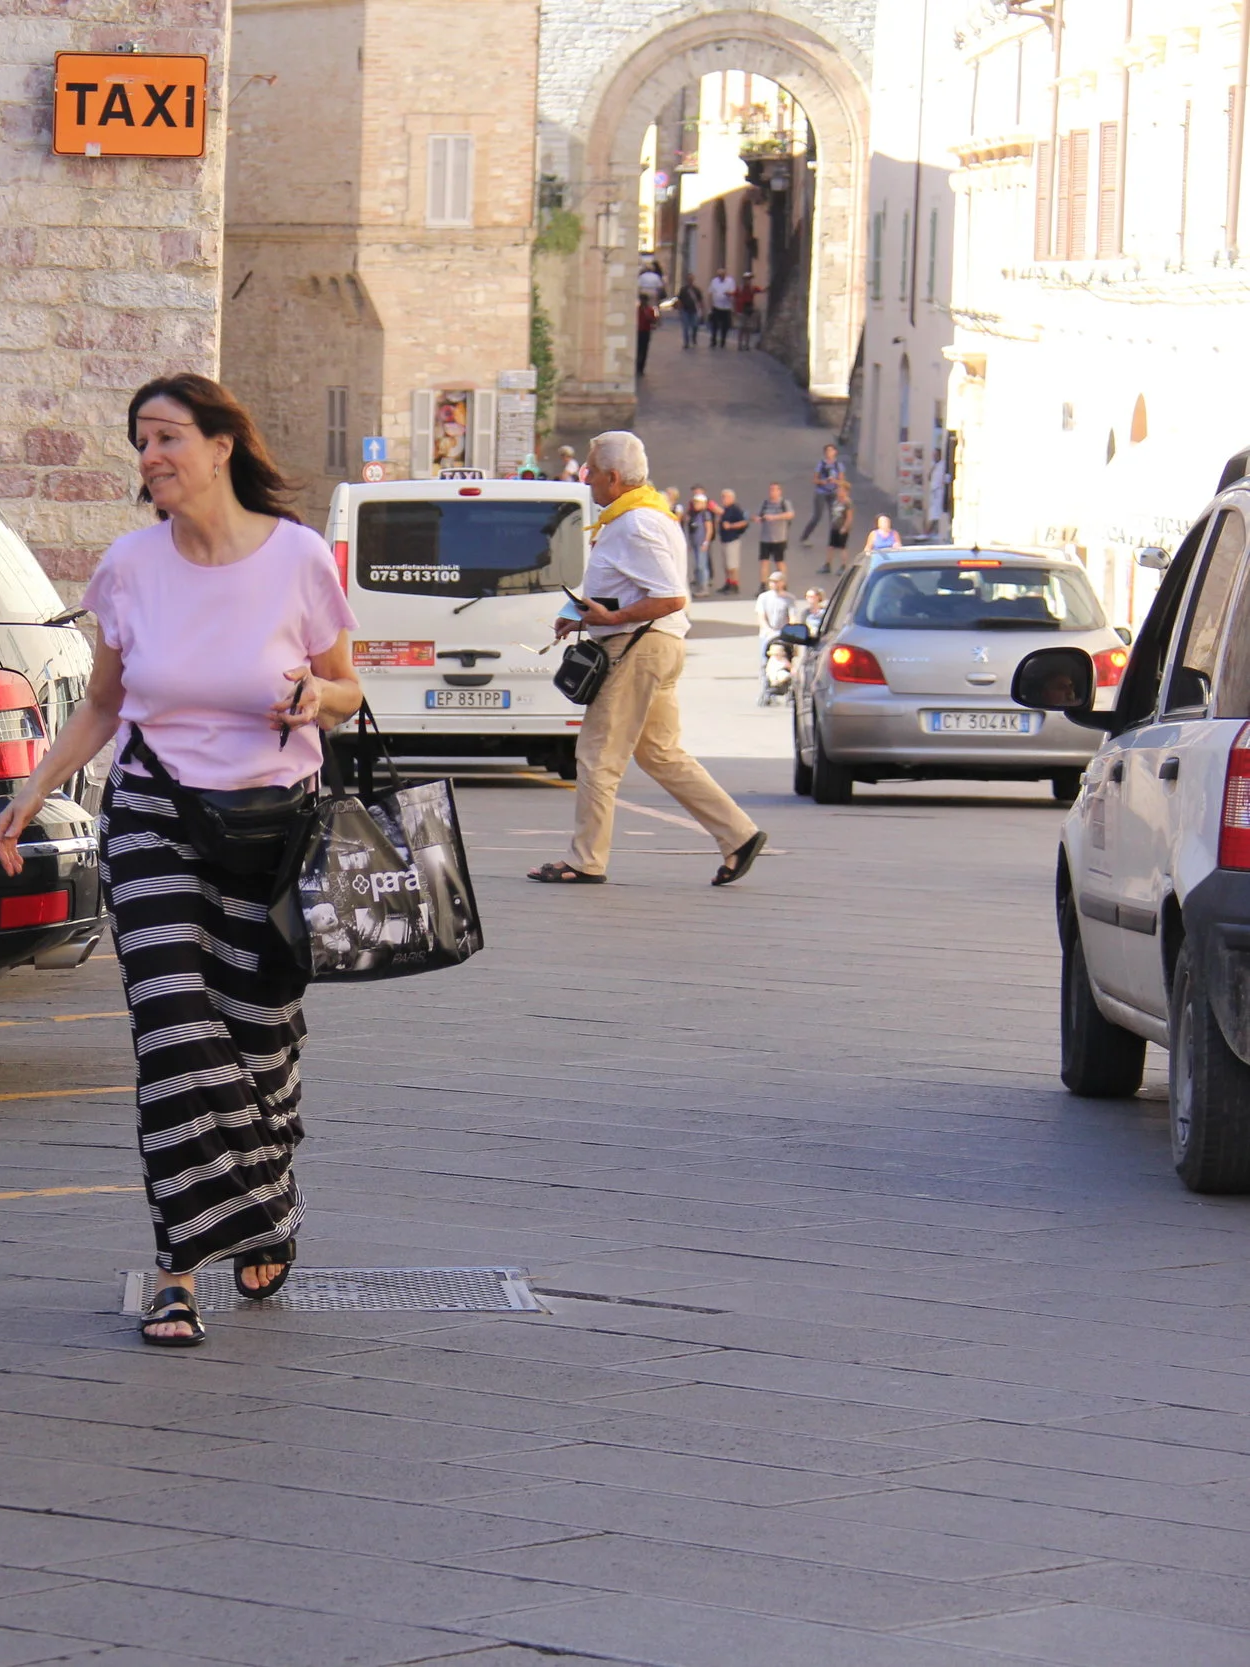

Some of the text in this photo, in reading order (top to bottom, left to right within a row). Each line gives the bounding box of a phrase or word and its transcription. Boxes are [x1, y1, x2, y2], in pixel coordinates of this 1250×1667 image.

[65, 82, 196, 128] TAXI
[442, 471, 480, 480] TAXI
[370, 570, 461, 582] 075 813100
[437, 692, 453, 705] EP
[458, 692, 501, 706] 831PP
[942, 714, 1019, 730] CY 304AK
